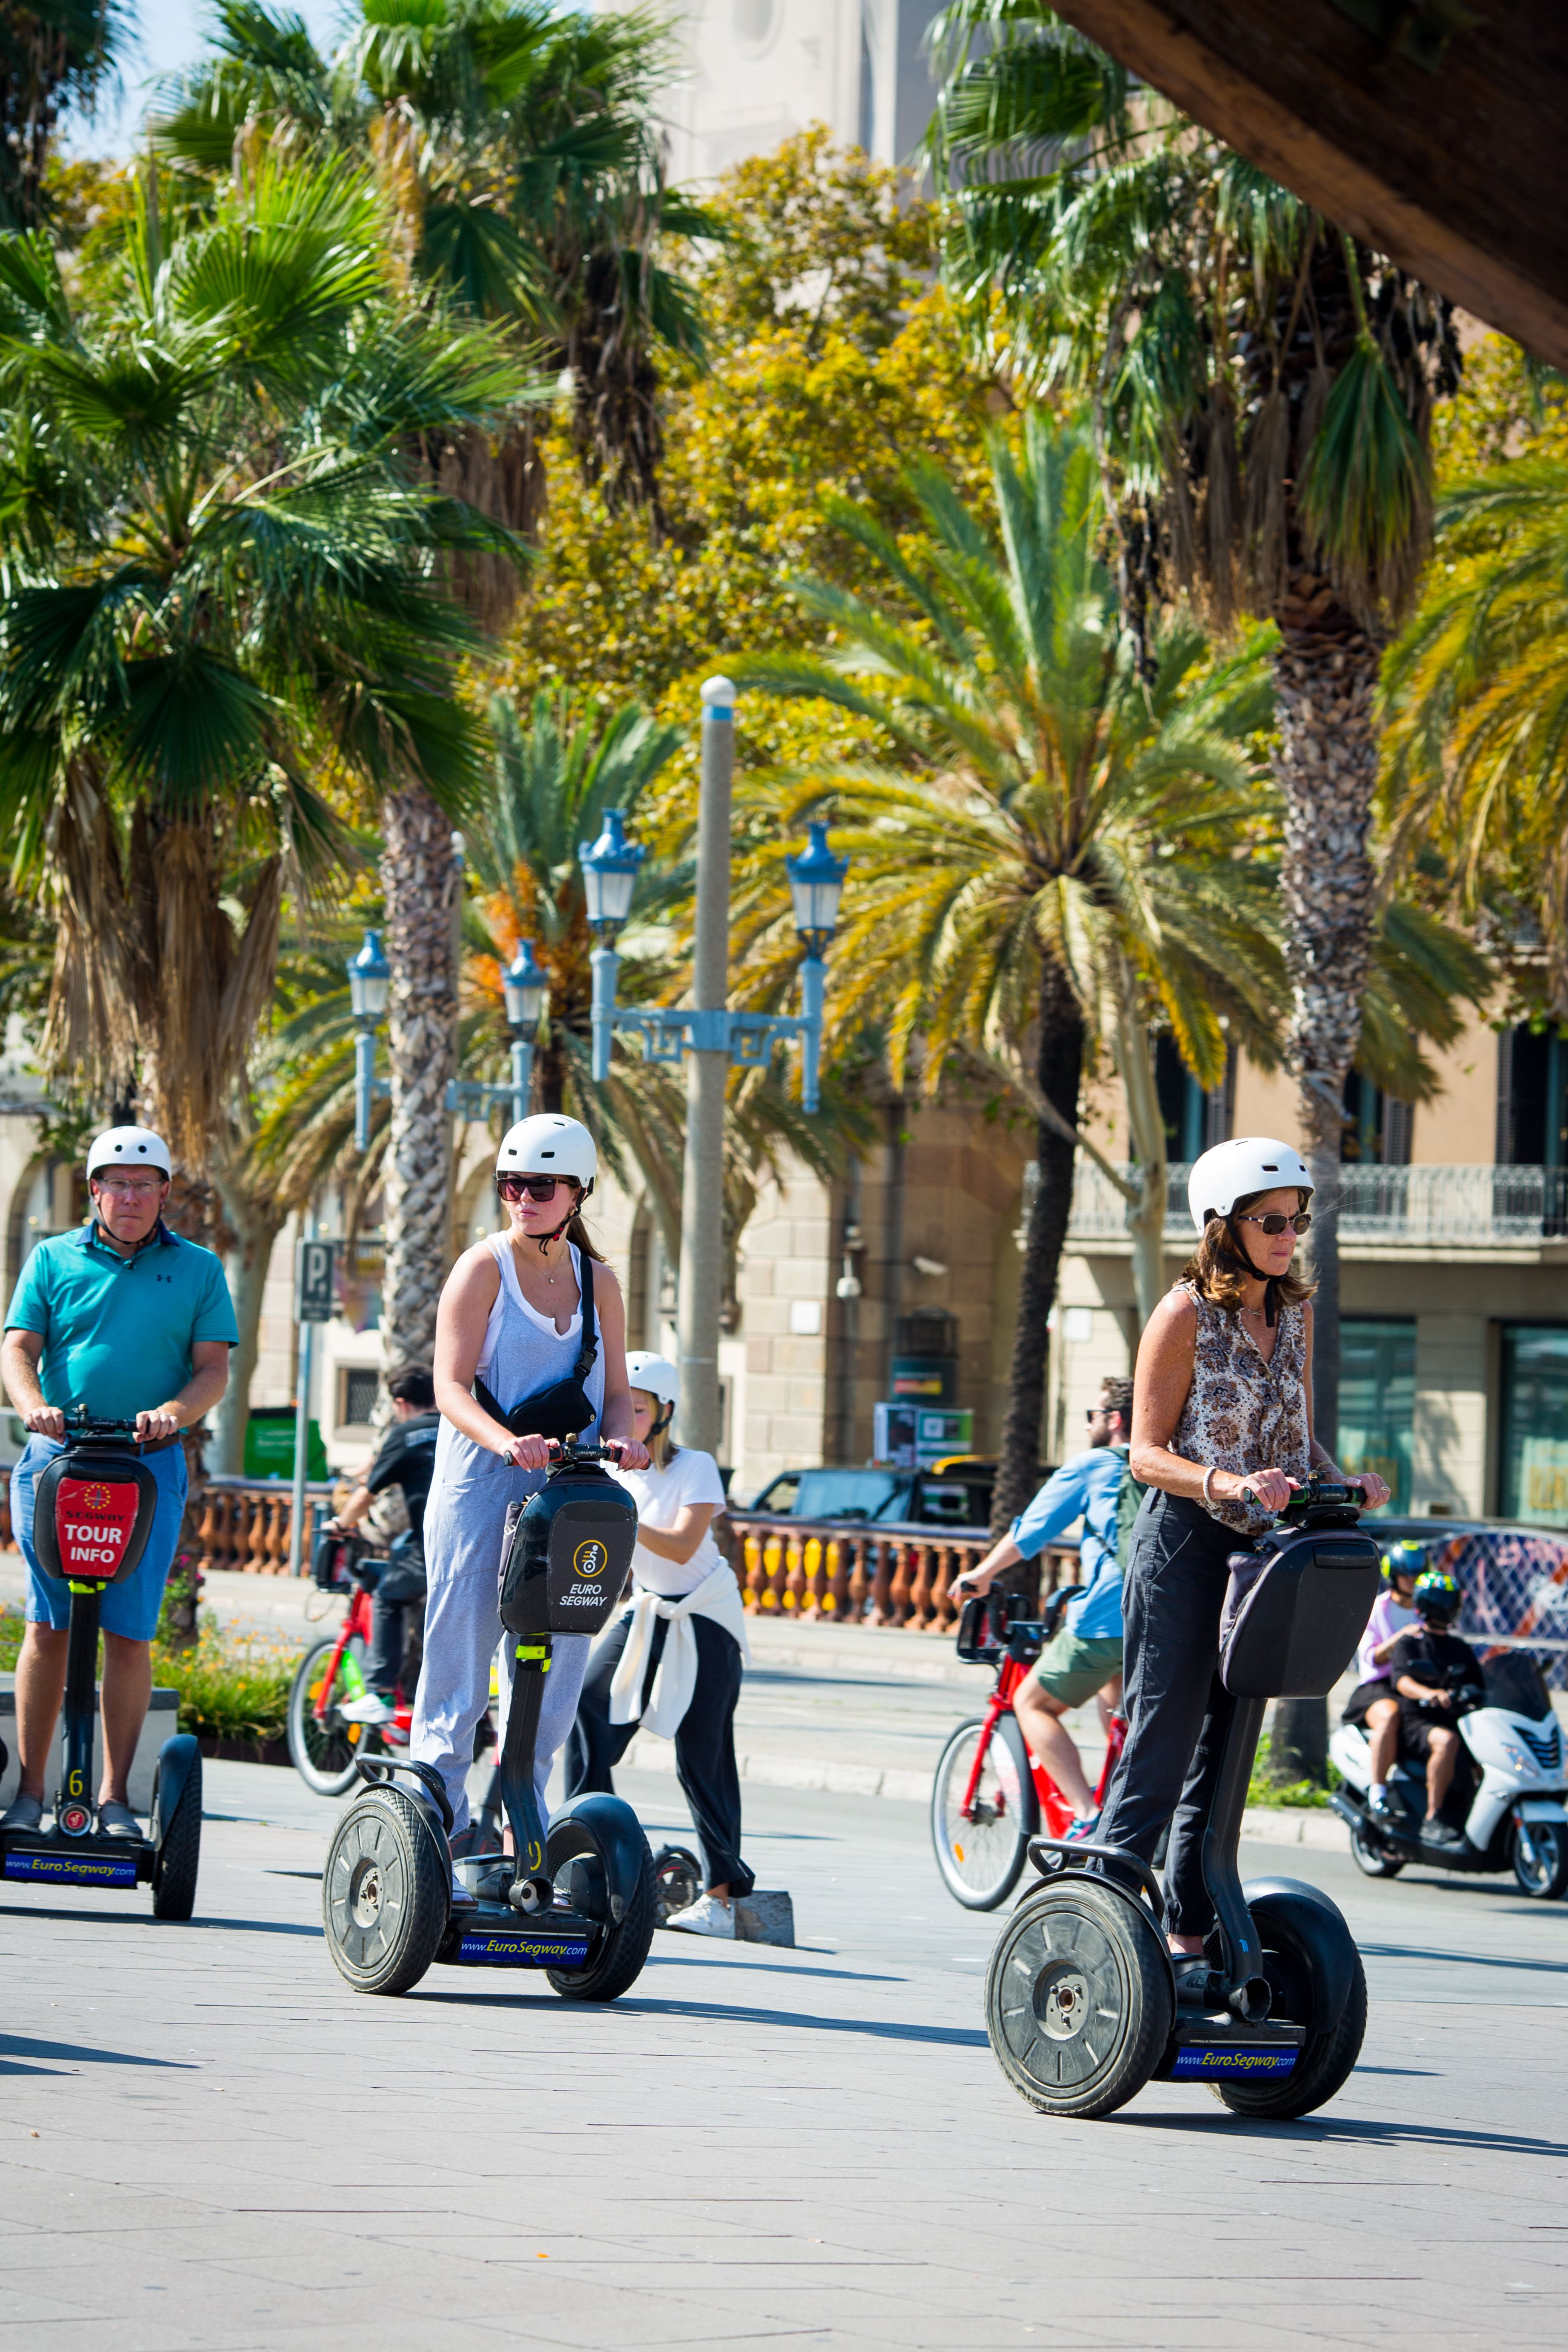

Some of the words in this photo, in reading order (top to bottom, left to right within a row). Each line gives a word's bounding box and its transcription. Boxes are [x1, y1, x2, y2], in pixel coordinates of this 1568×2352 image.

[307, 1246, 327, 1292] P
[66, 1511, 126, 1521] SEGWAY
[64, 1524, 122, 1544] TOUR
[70, 1547, 115, 1563] INFO
[570, 1584, 602, 1595] EURO
[559, 1595, 608, 1606] SEGWAY
[69, 1769, 83, 1796] 6
